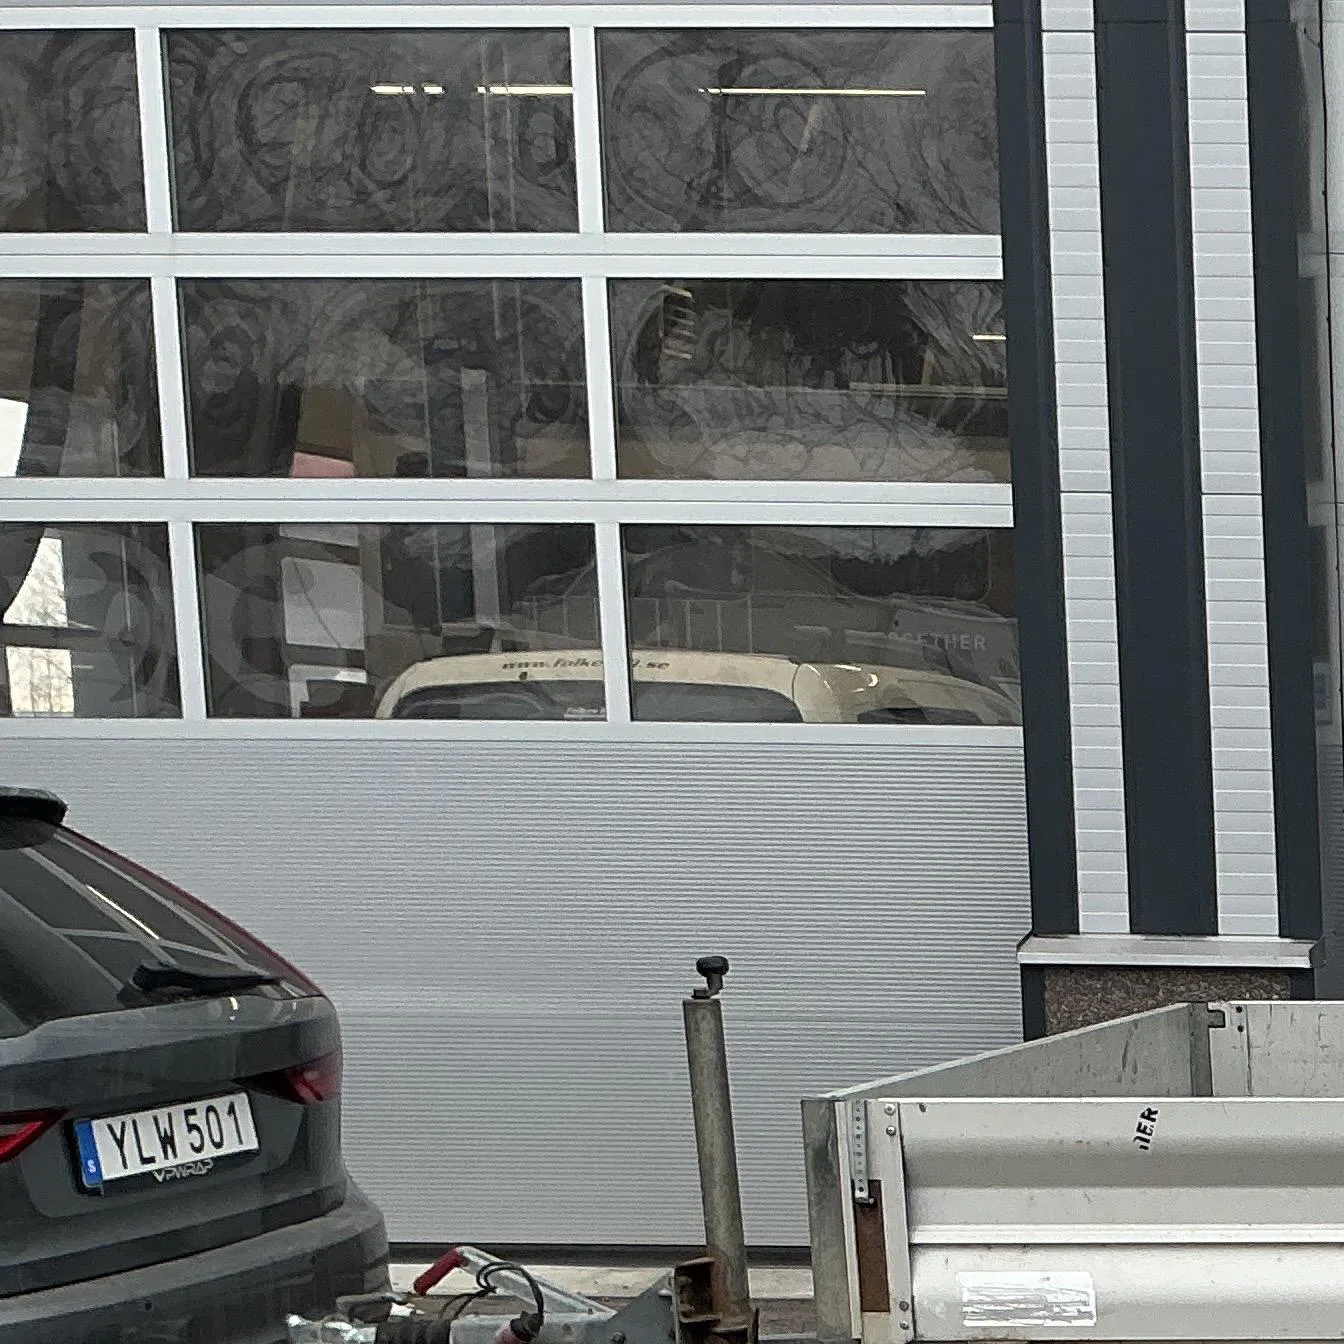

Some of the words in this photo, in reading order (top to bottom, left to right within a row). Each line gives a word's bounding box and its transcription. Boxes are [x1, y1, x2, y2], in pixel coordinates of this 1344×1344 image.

[106, 1112, 178, 1170] YLW
[183, 1101, 244, 1154] 501
[87, 1159, 98, 1174] S
